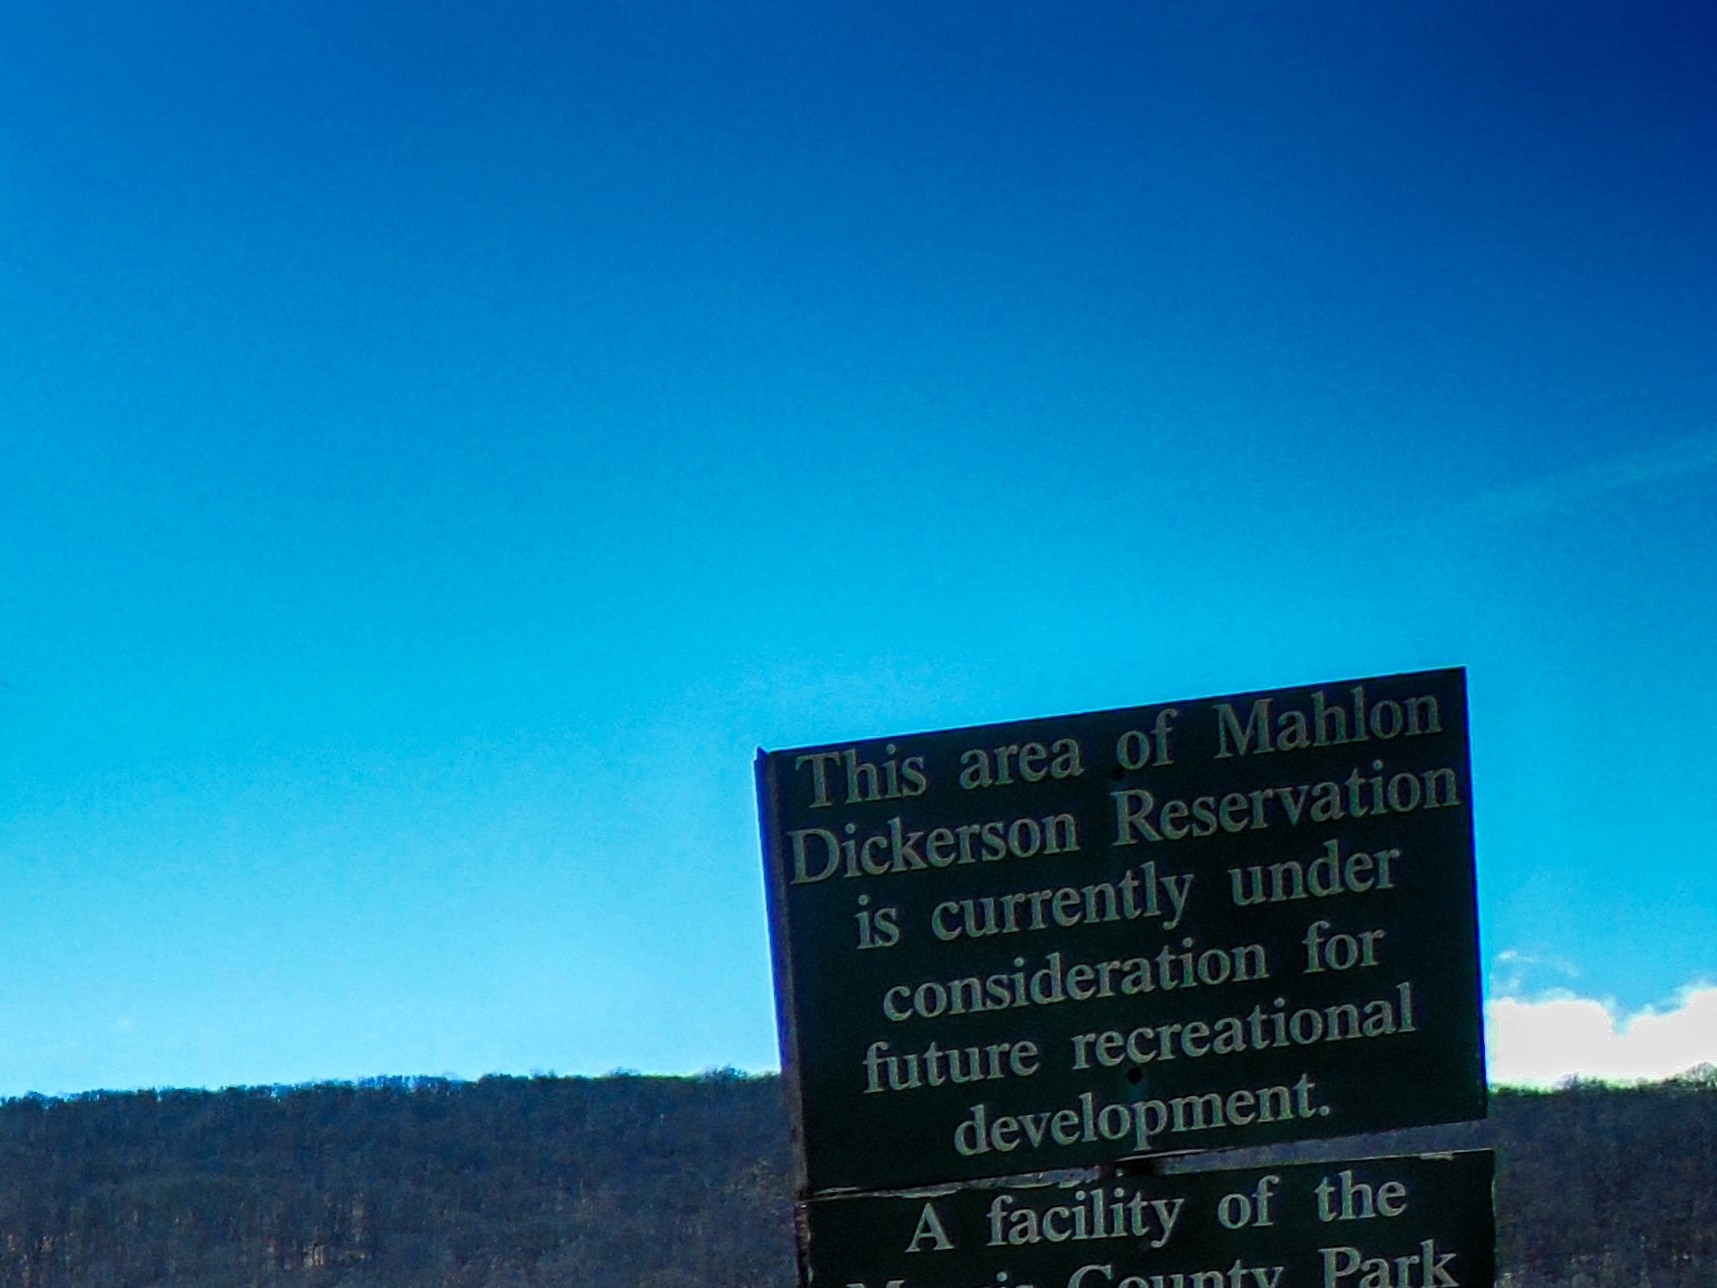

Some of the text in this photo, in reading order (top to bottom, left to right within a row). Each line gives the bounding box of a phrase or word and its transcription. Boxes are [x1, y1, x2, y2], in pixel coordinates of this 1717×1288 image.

[796, 689, 1442, 808] This area of Mahlon
[791, 762, 1460, 884] Dickerson Reservation
[857, 843, 1399, 949] is currently under
[883, 921, 1384, 1023] consideration for
[862, 984, 1416, 1094] future recreational
[955, 1074, 1330, 1155] development.
[906, 1171, 1407, 1253] A facility of the
